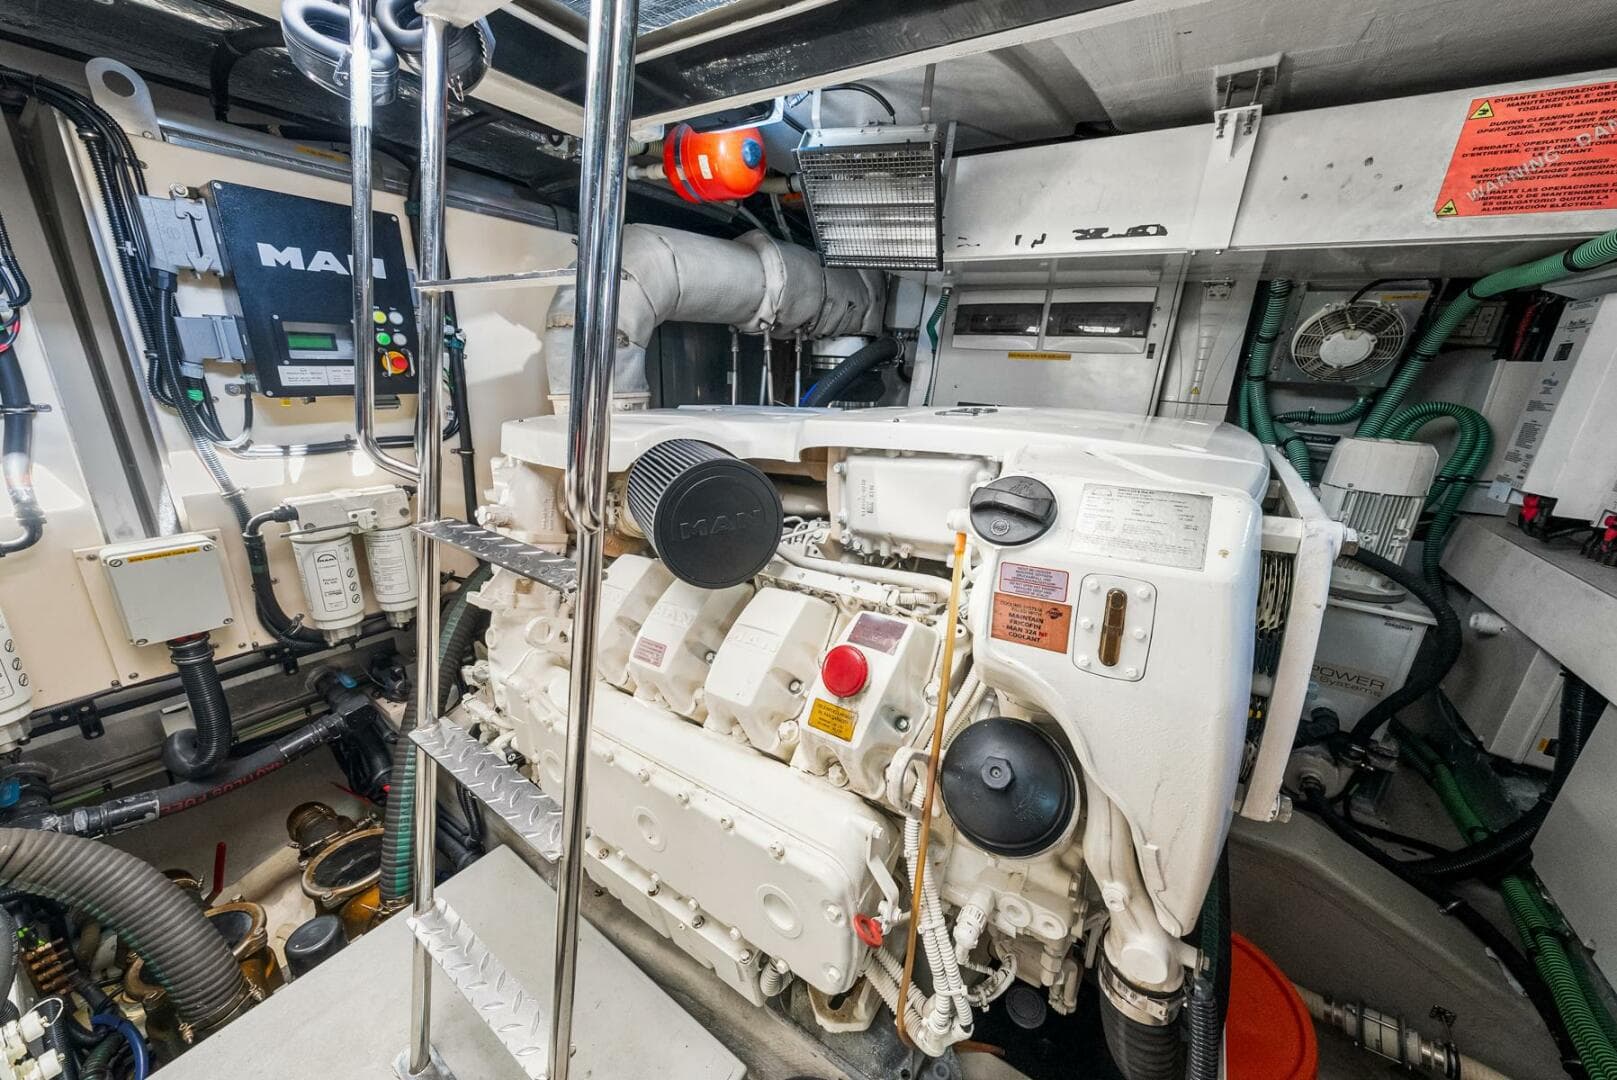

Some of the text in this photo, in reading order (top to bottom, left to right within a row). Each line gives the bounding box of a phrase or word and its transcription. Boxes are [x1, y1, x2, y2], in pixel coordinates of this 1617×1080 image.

[1494, 84, 1610, 104] DURANTE L'OPERAZIONE
[1506, 94, 1581, 108] MANUTENZIONE
[1518, 103, 1563, 112] TOGLIERE
[1527, 114, 1574, 122] CLEANING
[1560, 117, 1596, 125] POWER
[1507, 122, 1611, 136] OBLIGATORY SWITCHE
[1550, 158, 1610, 167] REINIGUNGS
[1466, 150, 1559, 202] WARNING
[1540, 182, 1608, 192] OPERACIONES
[1481, 204, 1547, 212] ALIMENTACIÓN
[680, 507, 761, 540] MAN
[1008, 612, 1044, 624] MAINTAIN
[1006, 624, 1022, 632] MAN
[1008, 631, 1040, 642] COOLANT
